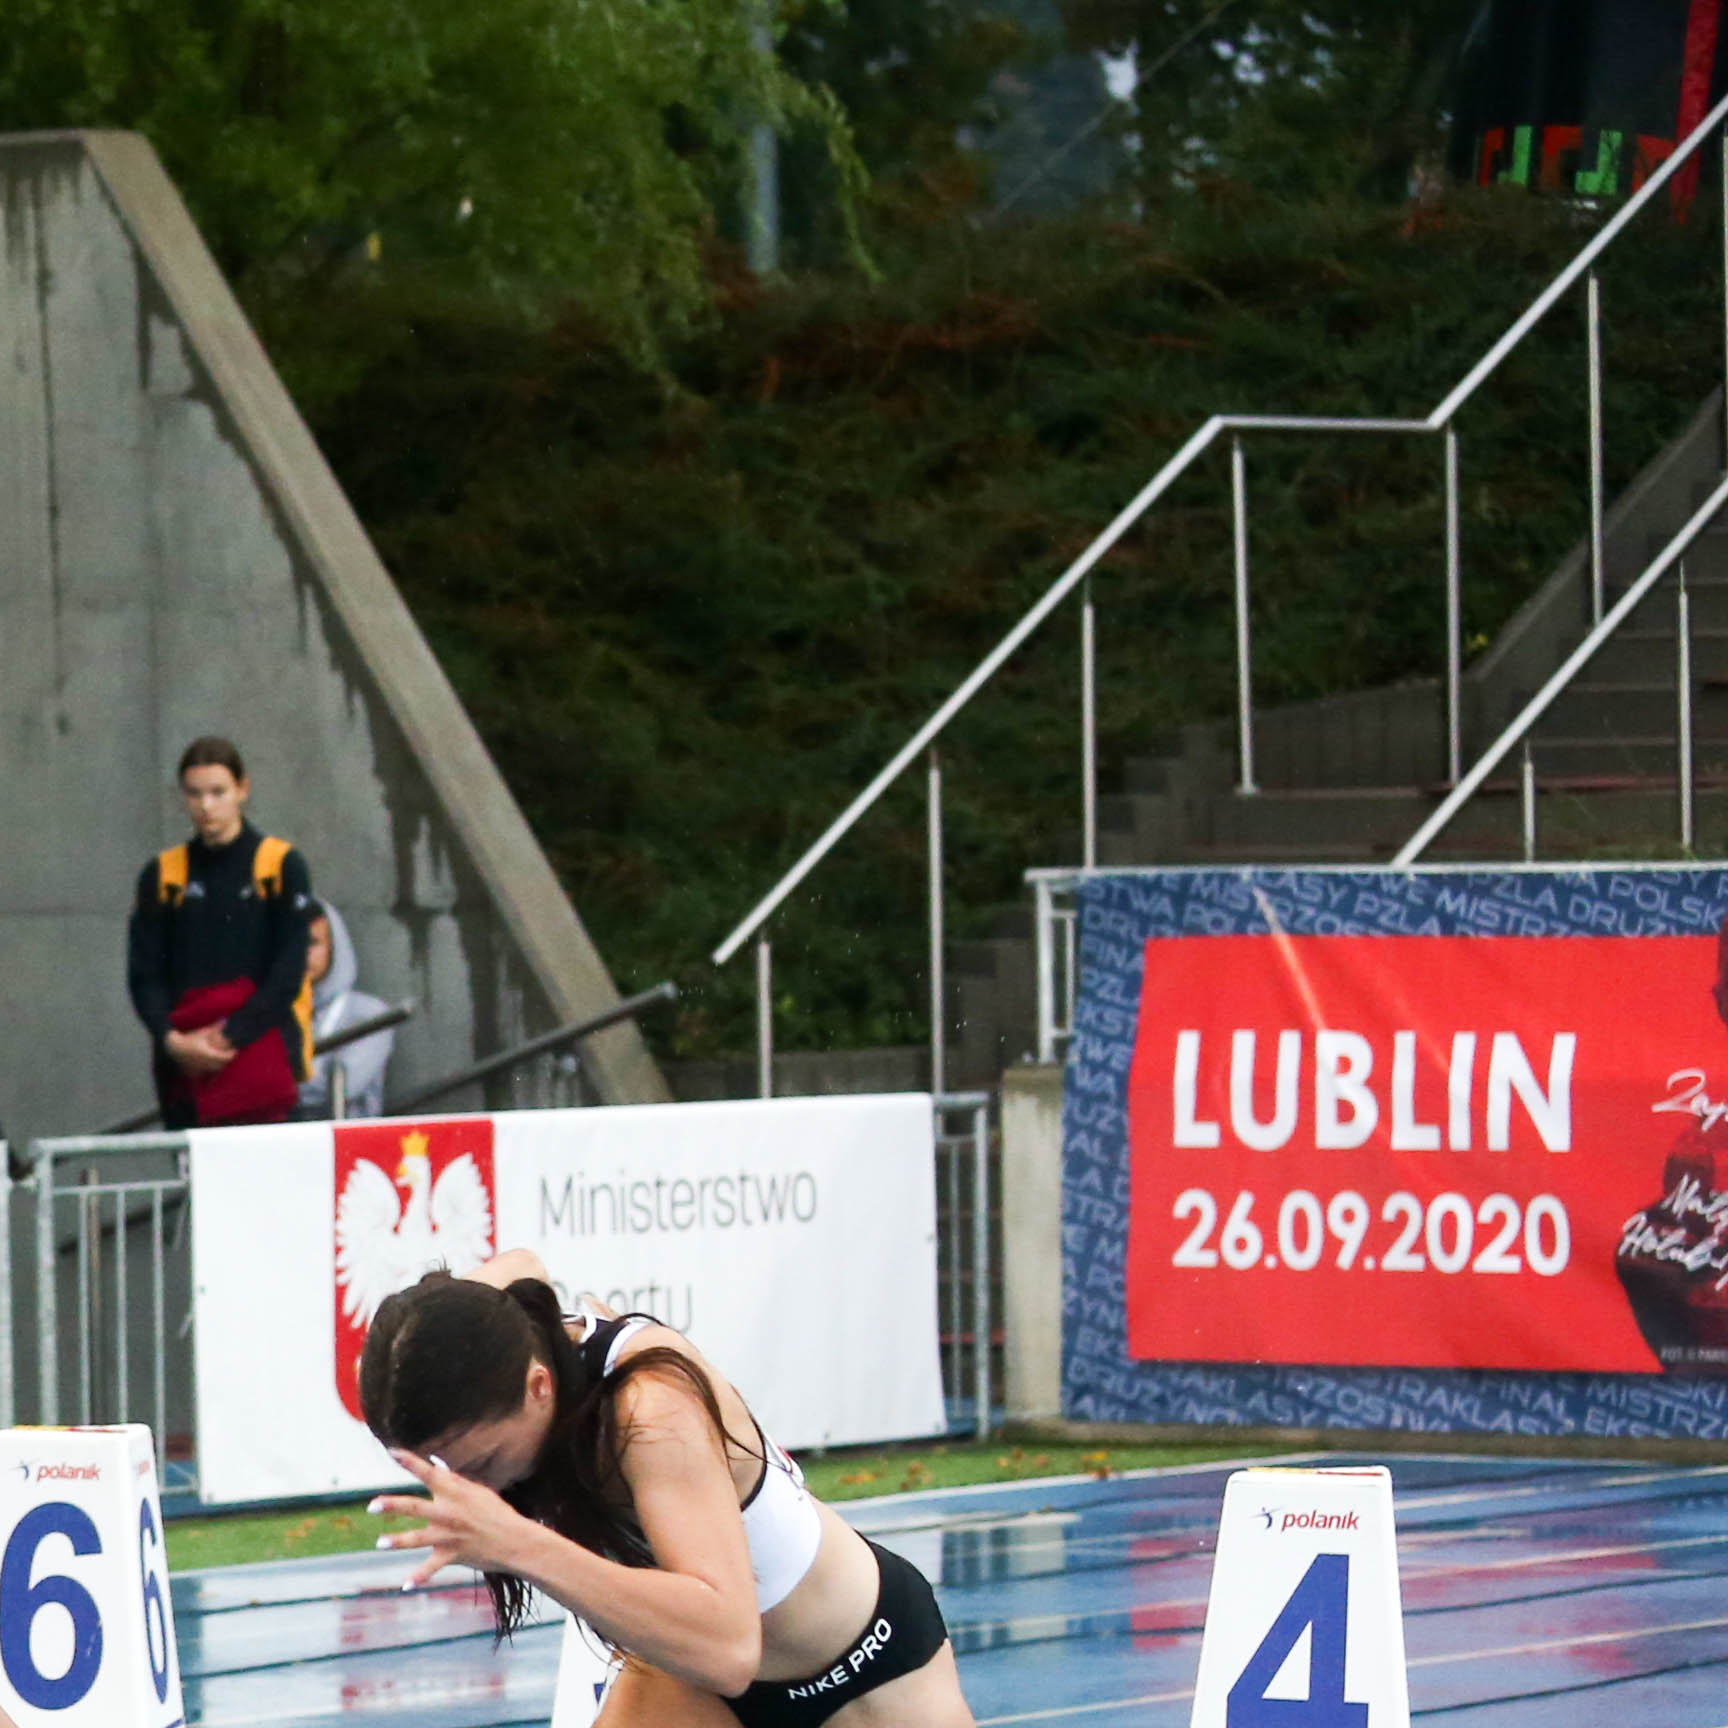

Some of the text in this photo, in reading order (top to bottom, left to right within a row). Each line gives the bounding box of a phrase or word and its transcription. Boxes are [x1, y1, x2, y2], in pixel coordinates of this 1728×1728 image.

[1173, 1030, 1576, 1152] LUBLIN
[539, 1169, 817, 1237] Ministerstwo
[1172, 1188, 1571, 1276] 26.09.2020
[36, 1462, 102, 1481] polanik
[1281, 1509, 1360, 1532] polanik
[140, 1496, 168, 1705] 6
[787, 1618, 892, 1700] NIKE PRO
